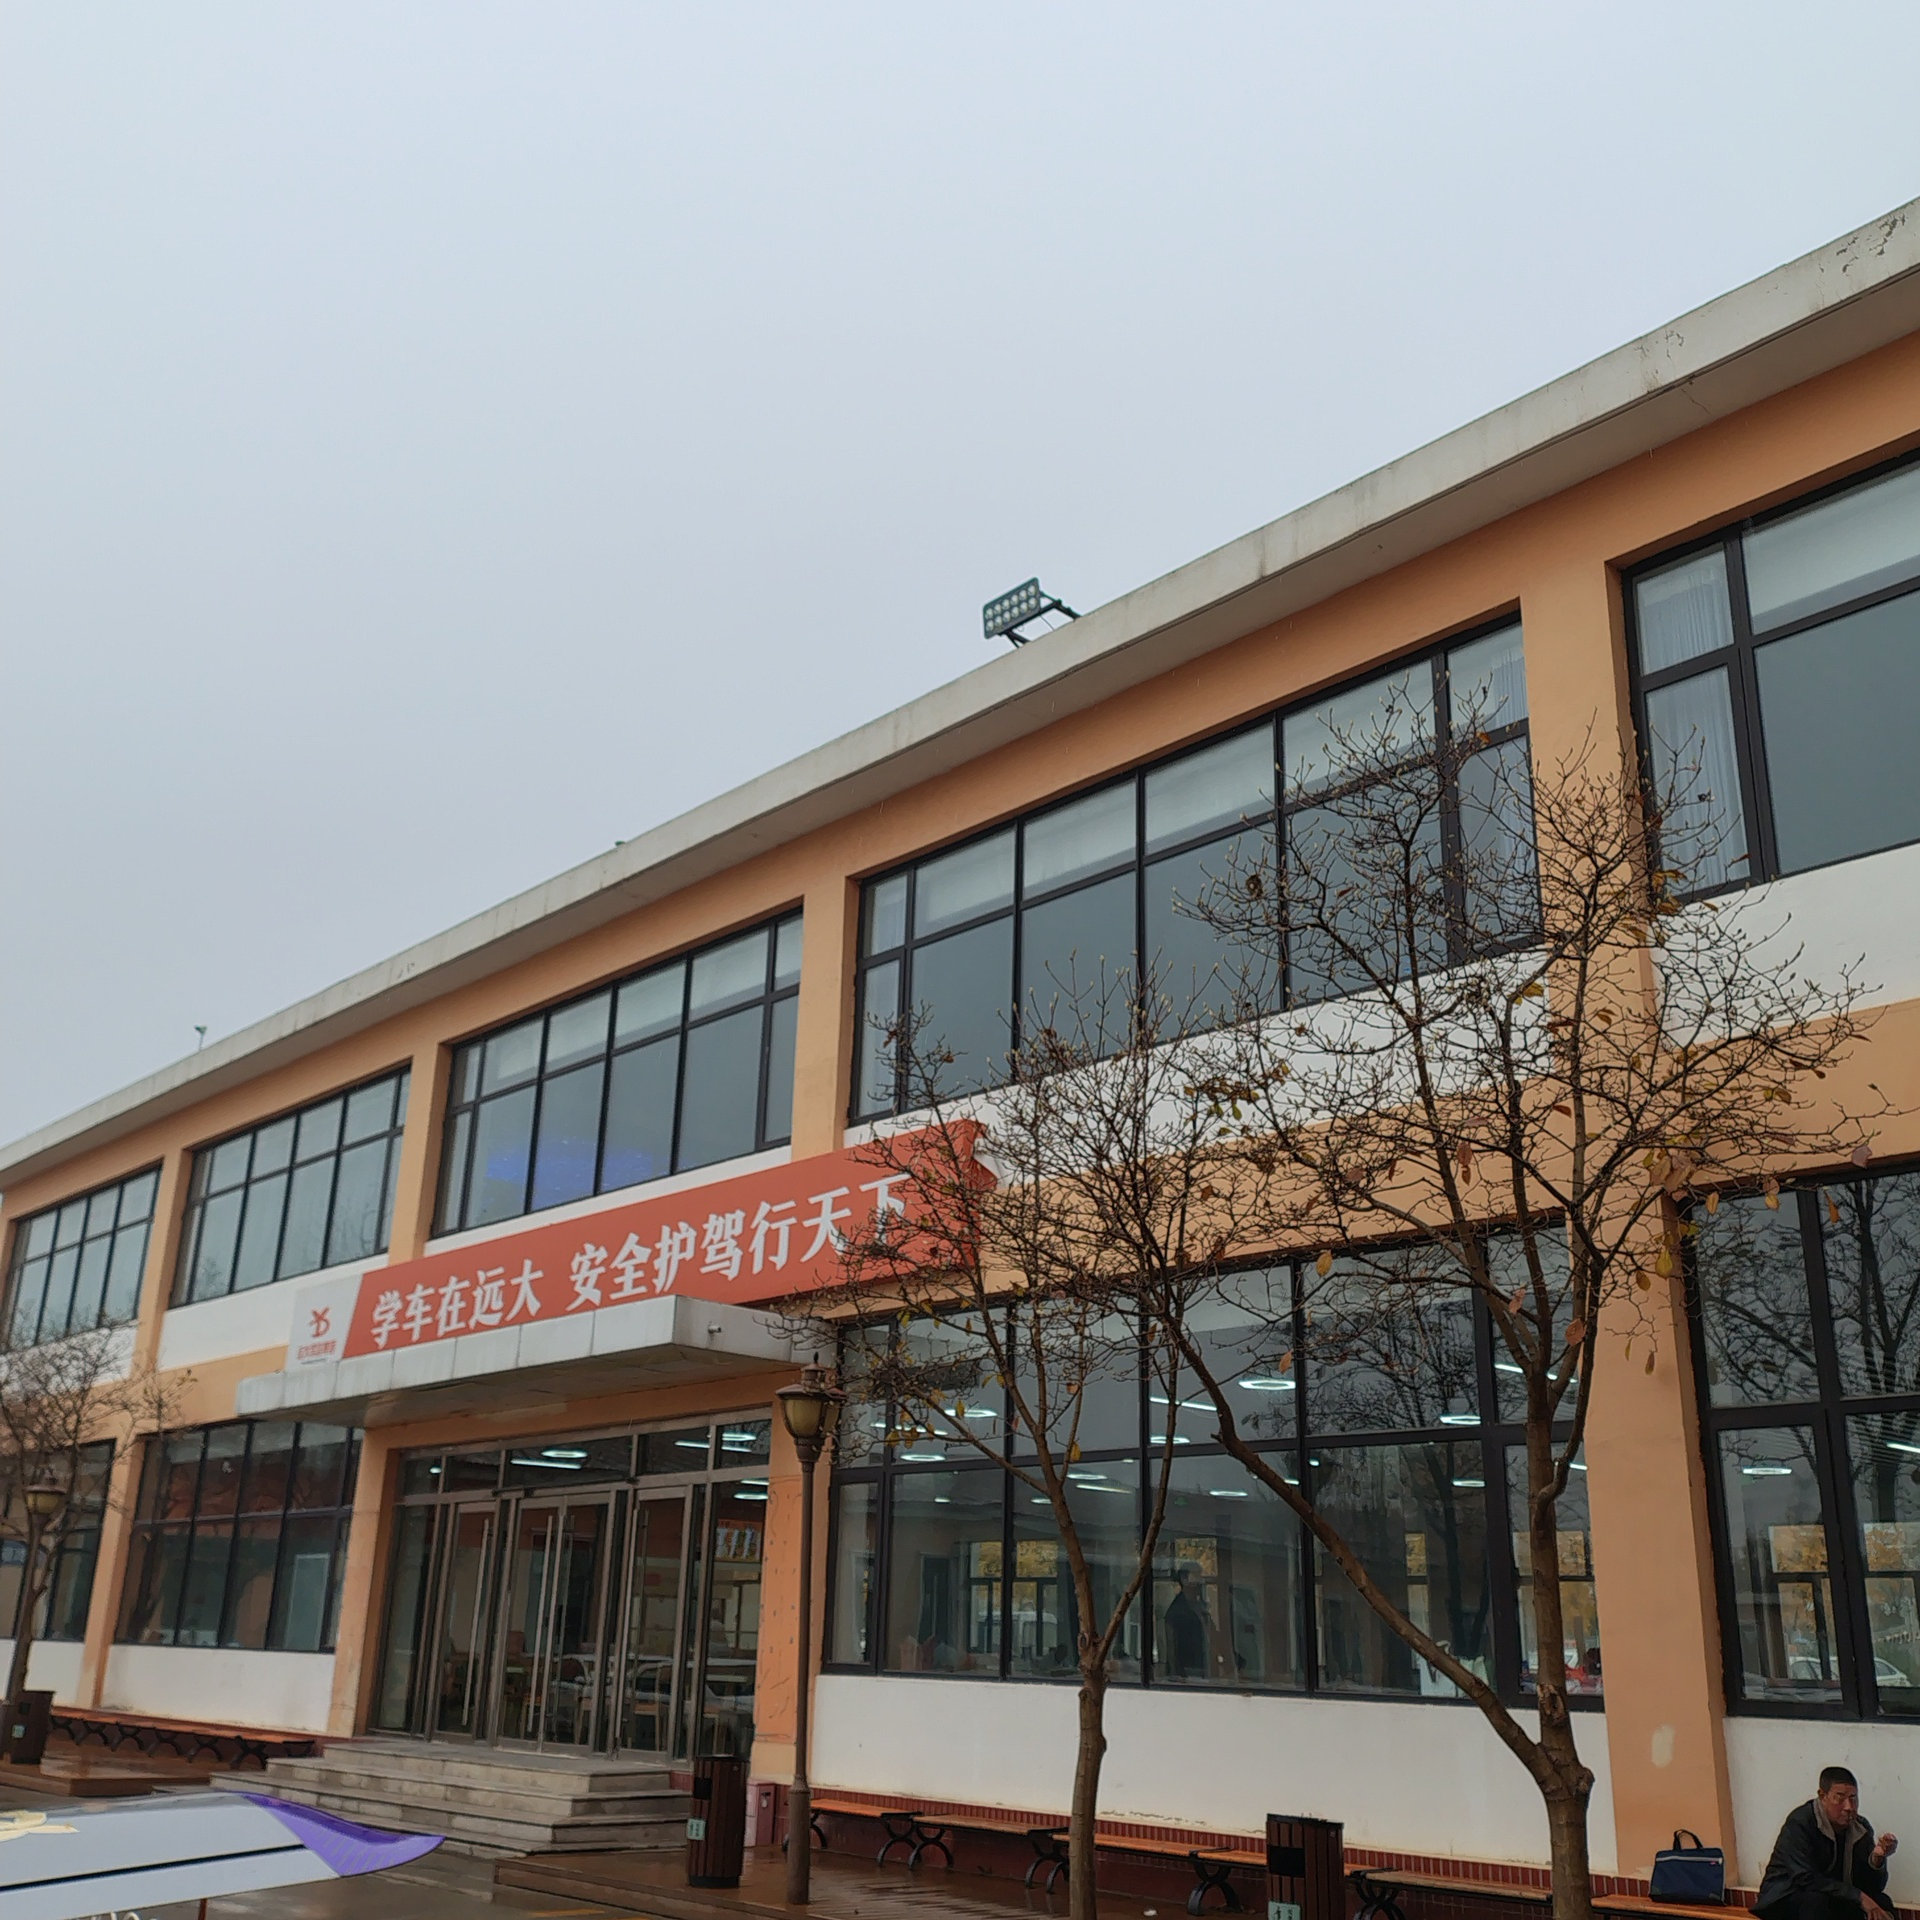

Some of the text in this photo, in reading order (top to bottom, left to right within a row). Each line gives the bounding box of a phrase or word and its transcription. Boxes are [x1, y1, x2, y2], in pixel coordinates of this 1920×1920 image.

[371, 1173, 912, 1349] 学车在远大 安全护驾行天下
